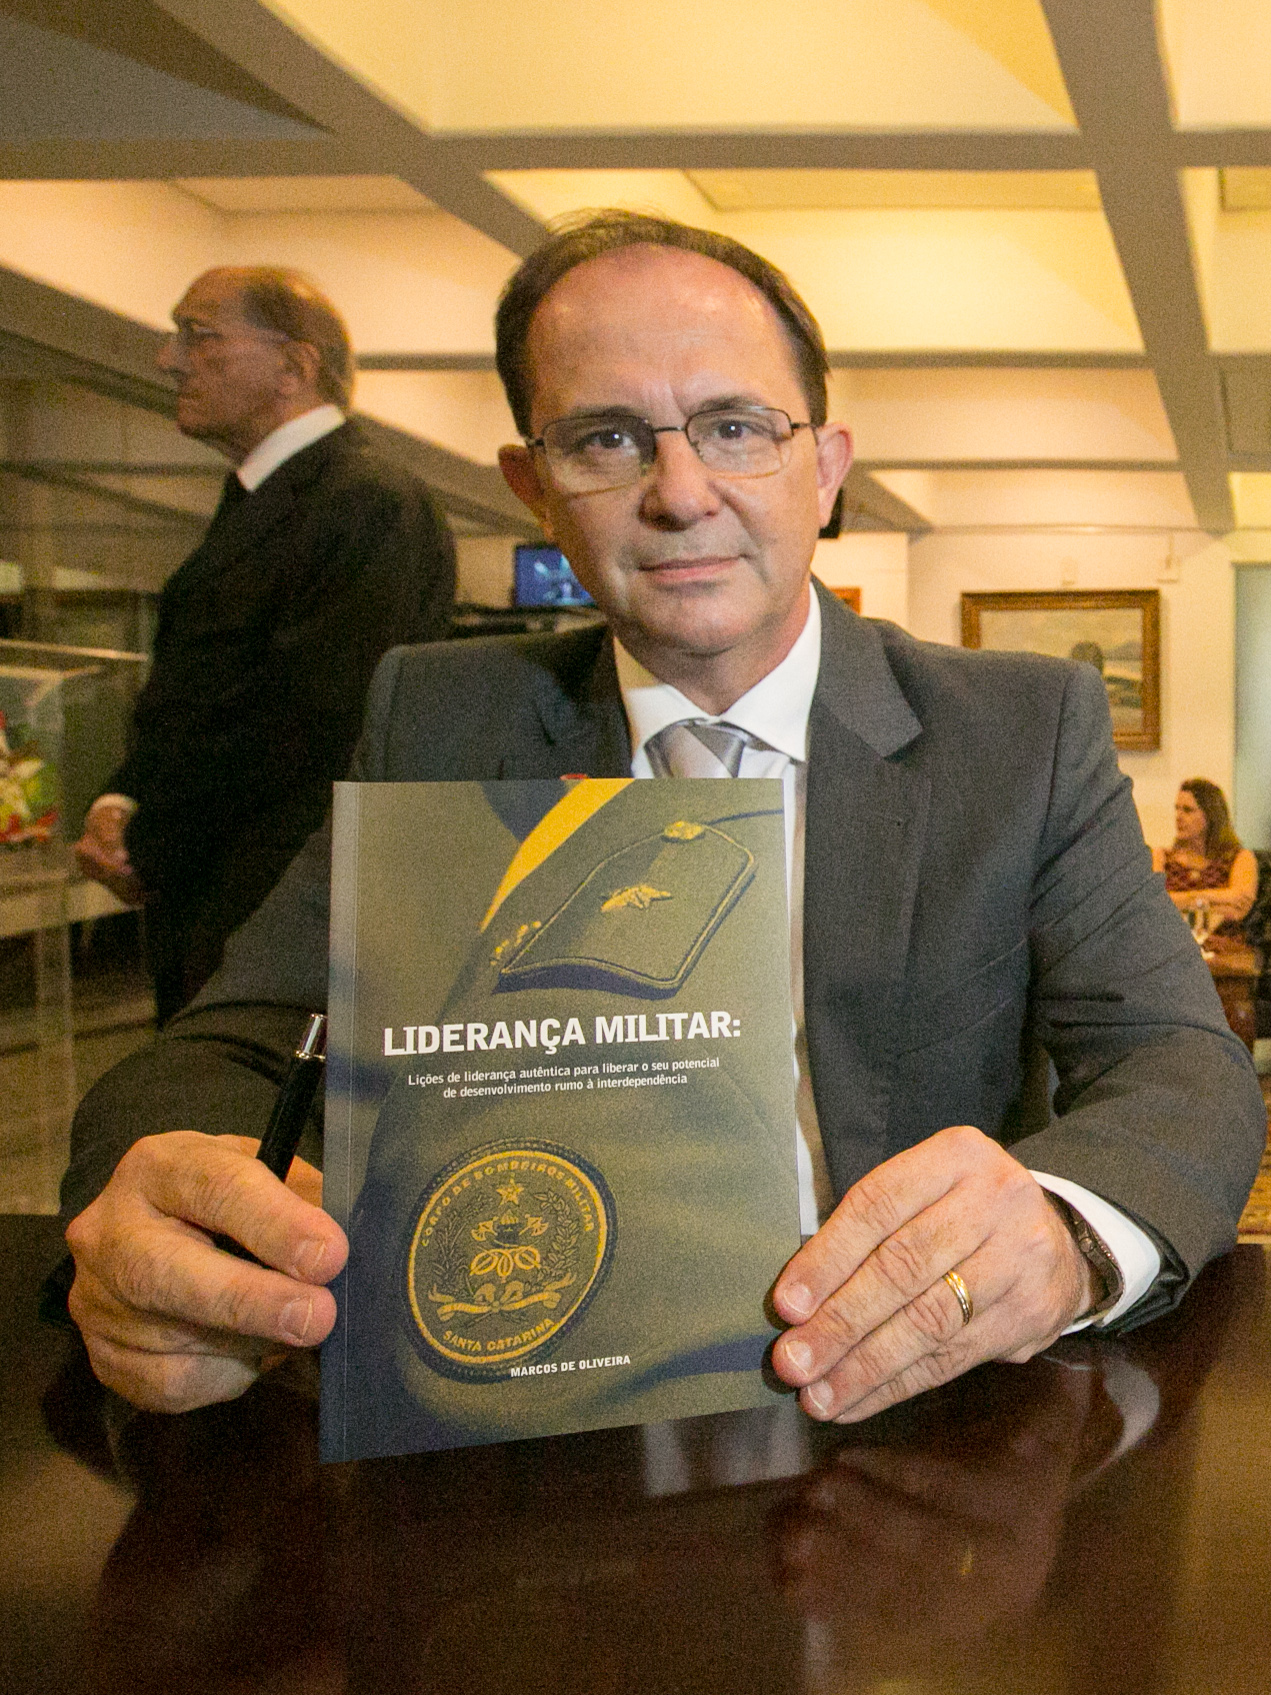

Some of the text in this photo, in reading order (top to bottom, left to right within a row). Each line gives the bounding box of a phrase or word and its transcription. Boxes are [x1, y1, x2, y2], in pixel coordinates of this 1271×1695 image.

[384, 1011, 741, 1056] LIDERANÇA MILITAR:
[408, 1057, 720, 1088] Lições de liderança autêntica para liberar o seu potencial
[443, 1073, 687, 1099] de desenvolvimento rumo à interdependência
[452, 1178, 472, 1196] DE
[473, 1160, 566, 1181] BOMBEIROS
[564, 1178, 595, 1232] MILITAR
[443, 1318, 556, 1352] SANTA CATARINA
[510, 1355, 631, 1378] MARCOS DE OLIVEIRA
